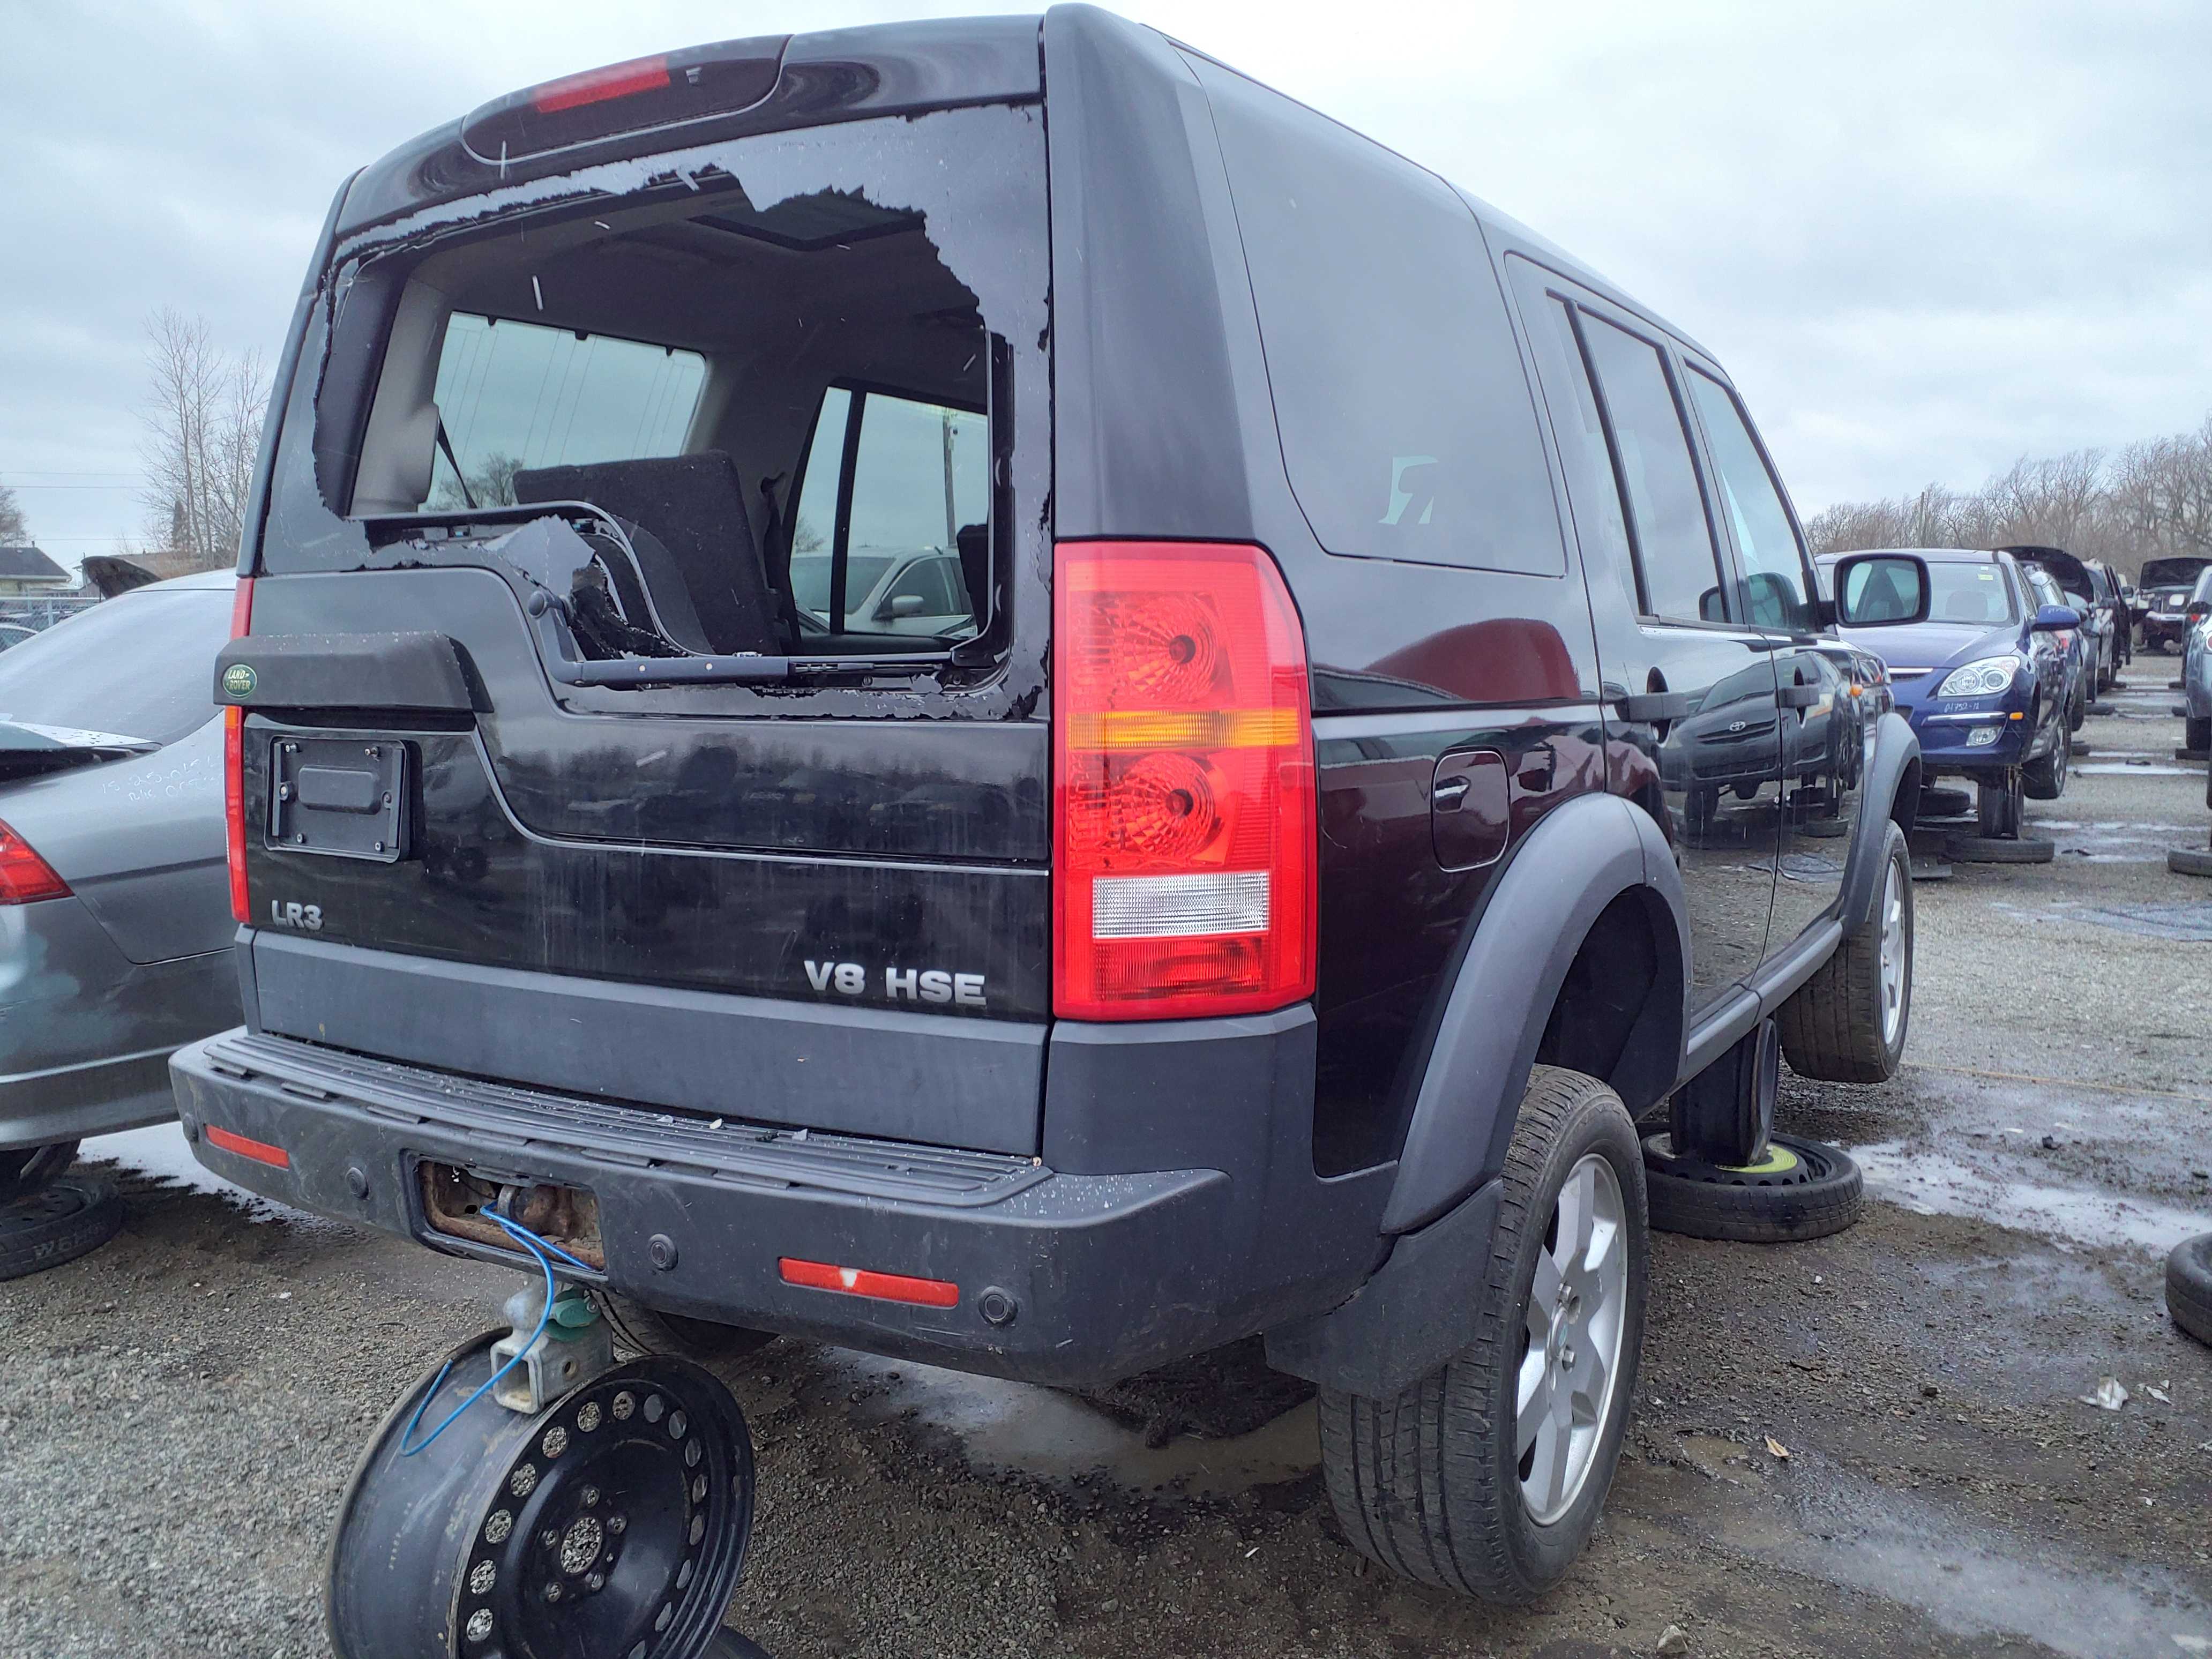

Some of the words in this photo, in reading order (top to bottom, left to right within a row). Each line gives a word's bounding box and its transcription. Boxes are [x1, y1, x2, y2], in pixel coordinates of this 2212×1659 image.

[228, 669, 245, 679] LAND
[229, 680, 251, 690] ROVER
[272, 900, 323, 931] LR3
[804, 960, 866, 995] V8
[886, 967, 987, 1006] HSE
